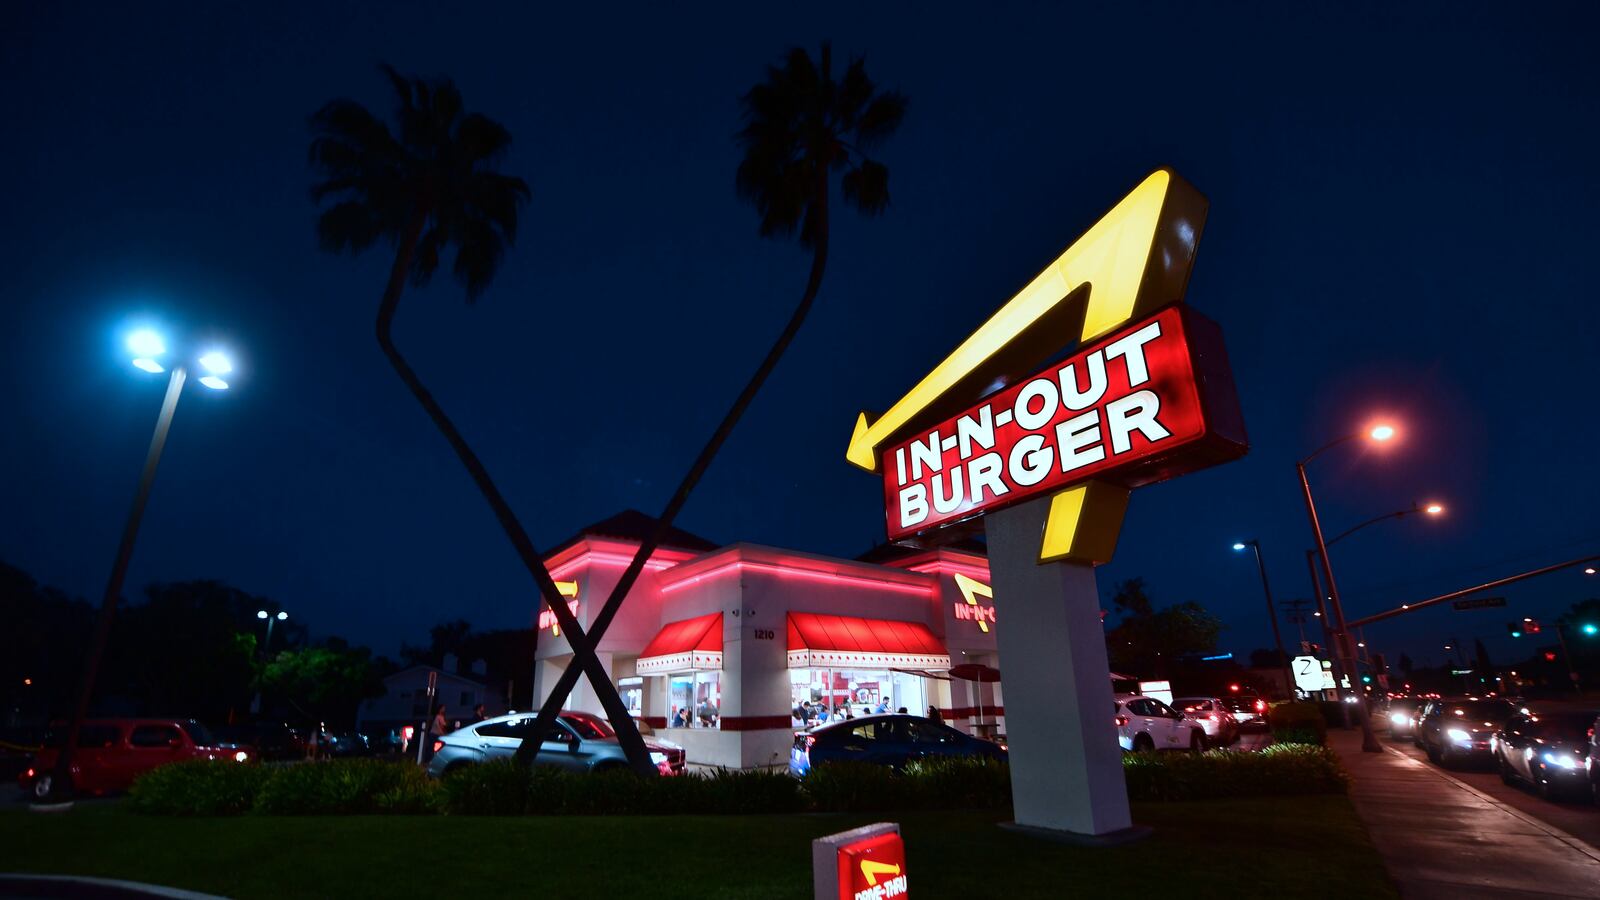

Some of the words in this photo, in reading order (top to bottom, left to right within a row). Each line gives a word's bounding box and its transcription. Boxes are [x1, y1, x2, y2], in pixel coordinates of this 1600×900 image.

[896, 321, 1162, 486] IN-N-OUT
[898, 389, 1173, 528] BURGER
[754, 629, 775, 641] 1210
